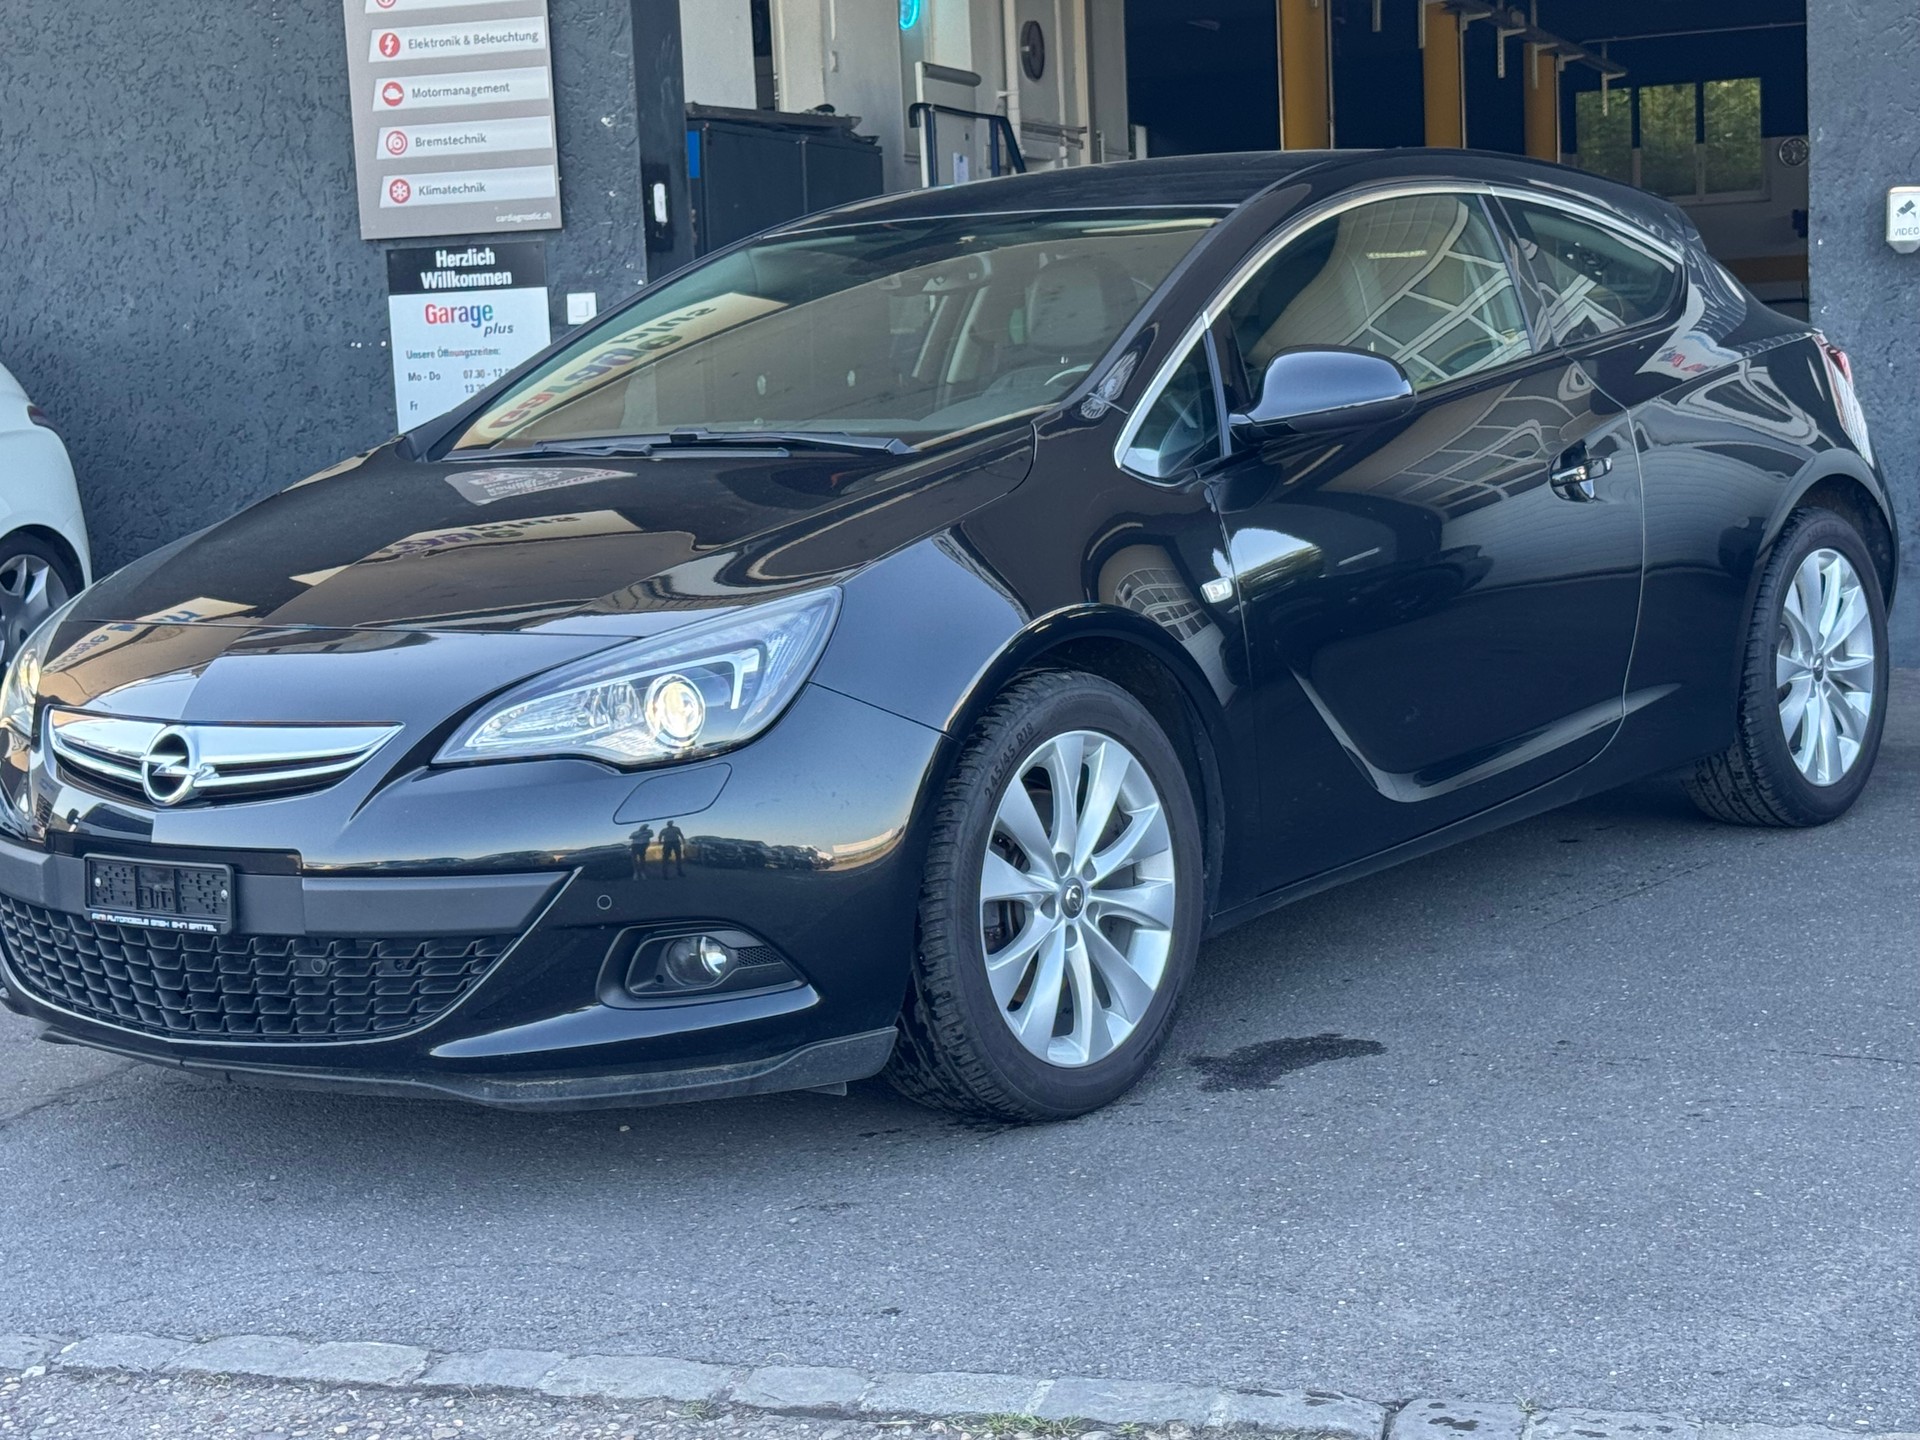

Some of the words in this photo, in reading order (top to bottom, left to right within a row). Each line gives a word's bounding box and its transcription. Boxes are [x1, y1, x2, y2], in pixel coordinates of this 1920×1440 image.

[408, 36, 461, 50] Elektronik
[463, 34, 471, 46] &
[473, 30, 539, 46] Beleuchtung
[412, 83, 510, 99] Motormanagement
[415, 133, 486, 147] Bremstechnik
[418, 182, 486, 196] Klimatechnik
[1894, 226, 1920, 236] VIDEO
[435, 248, 495, 268] Herzlich
[420, 271, 513, 289] Willkommen
[424, 303, 494, 328] Garage
[484, 322, 514, 337] plus
[406, 349, 436, 359] Unsere
[408, 371, 422, 382] Mo
[428, 371, 441, 381] Do
[463, 368, 486, 380] 07.30
[410, 401, 419, 411] Fr
[1016, 722, 1035, 745] R18
